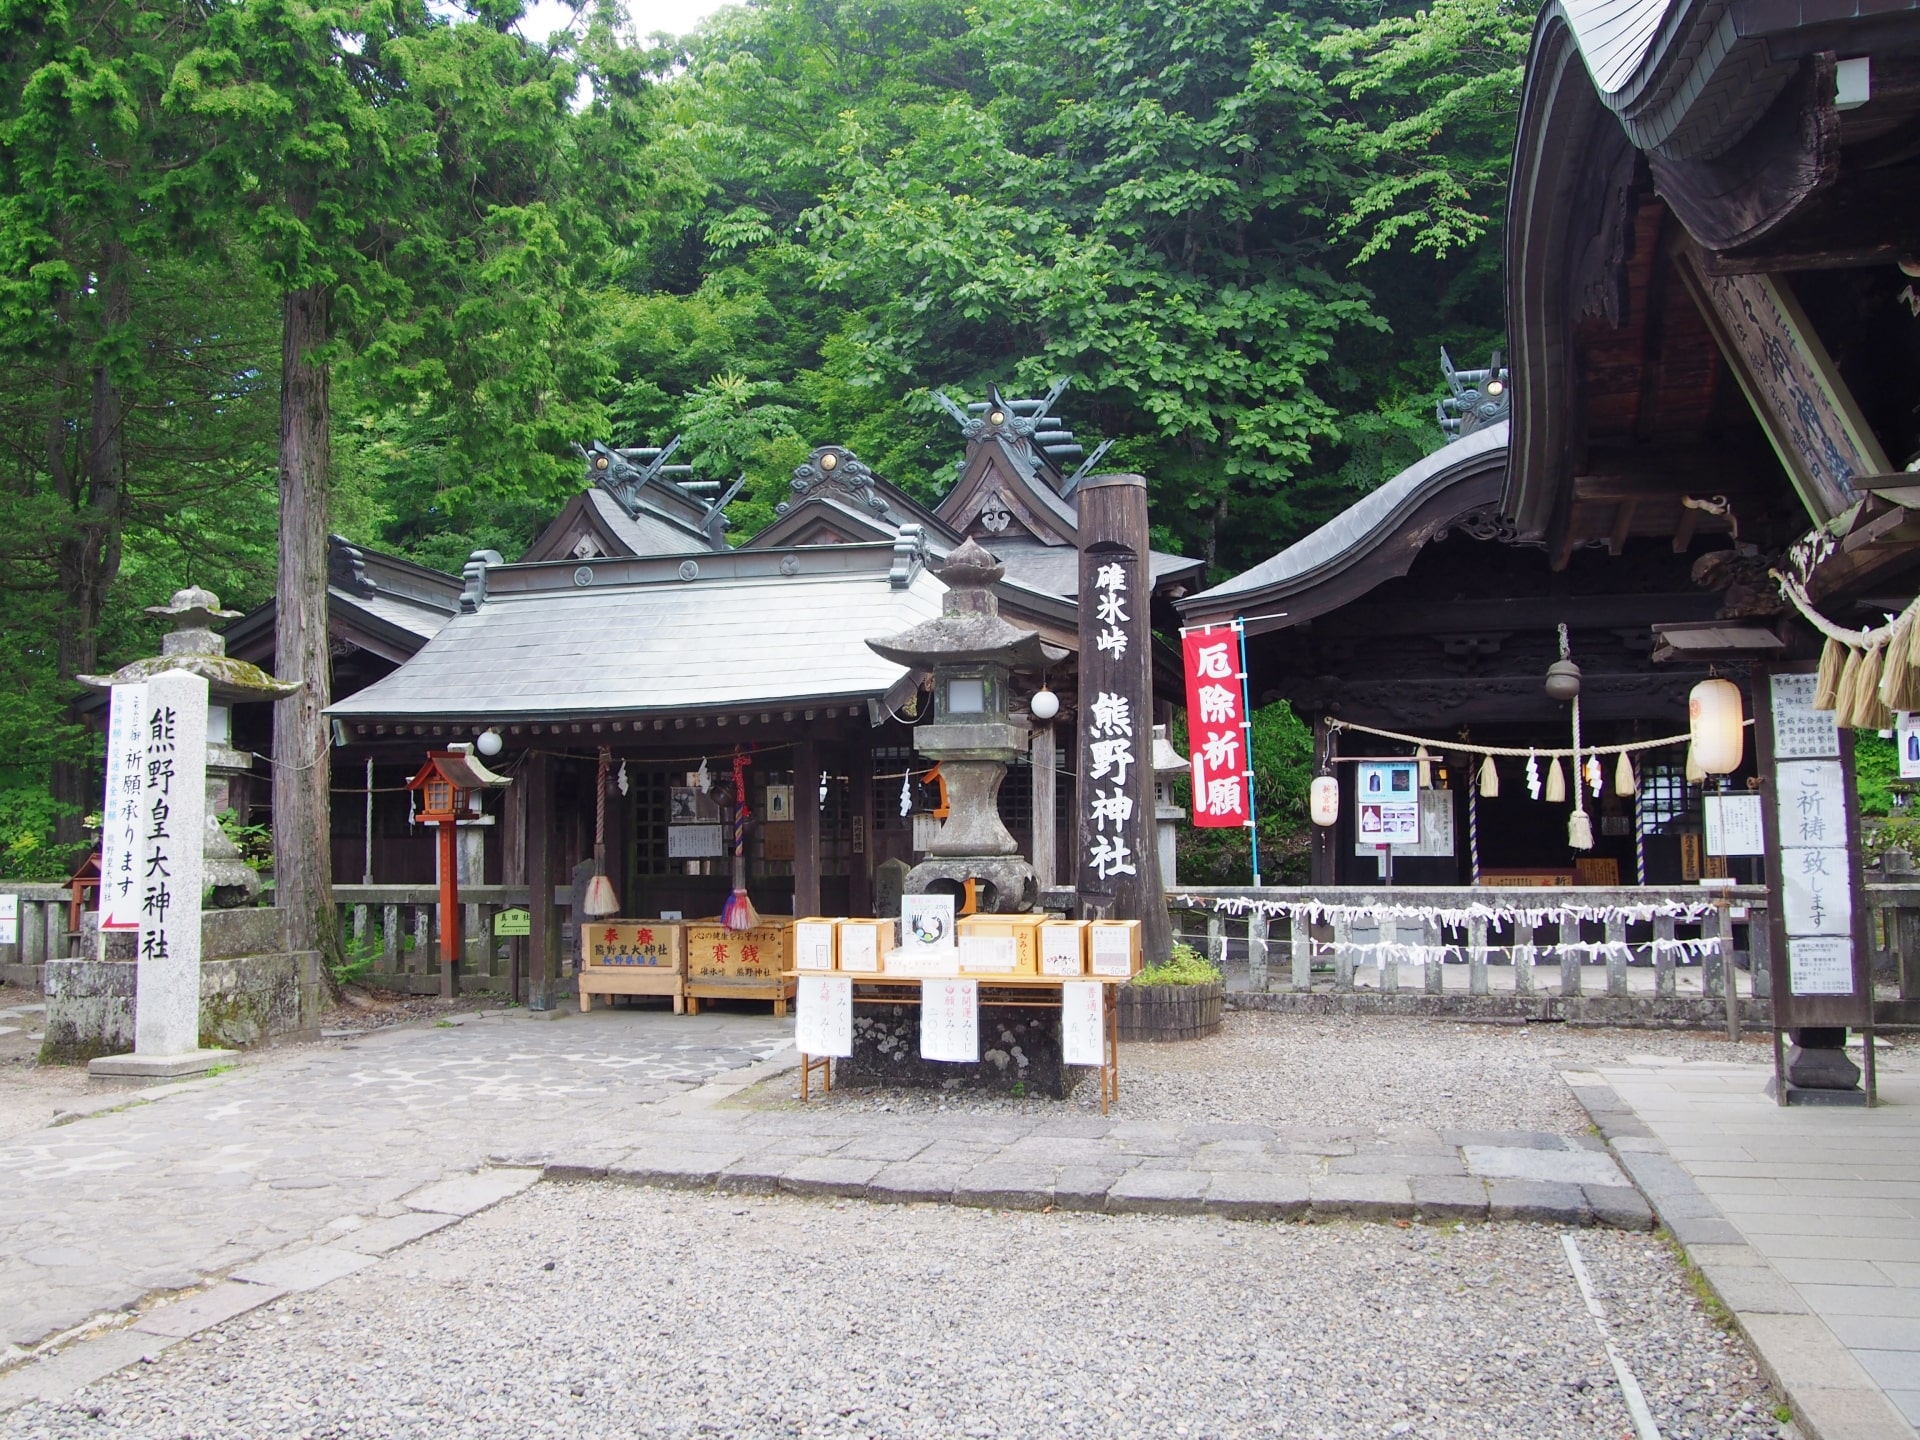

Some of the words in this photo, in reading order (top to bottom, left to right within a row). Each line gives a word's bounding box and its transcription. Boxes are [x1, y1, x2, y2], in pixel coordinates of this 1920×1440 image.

[1095, 562, 1130, 660] 碓氷峠
[1196, 642, 1242, 816] 厄除祈願
[142, 706, 177, 961] 熊野皇大神社
[1089, 691, 1137, 881] 熊野神社
[595, 944, 668, 956] 熊野皇大神社
[736, 966, 771, 977] 熊野神社
[1019, 932, 1029, 966] おみくじ
